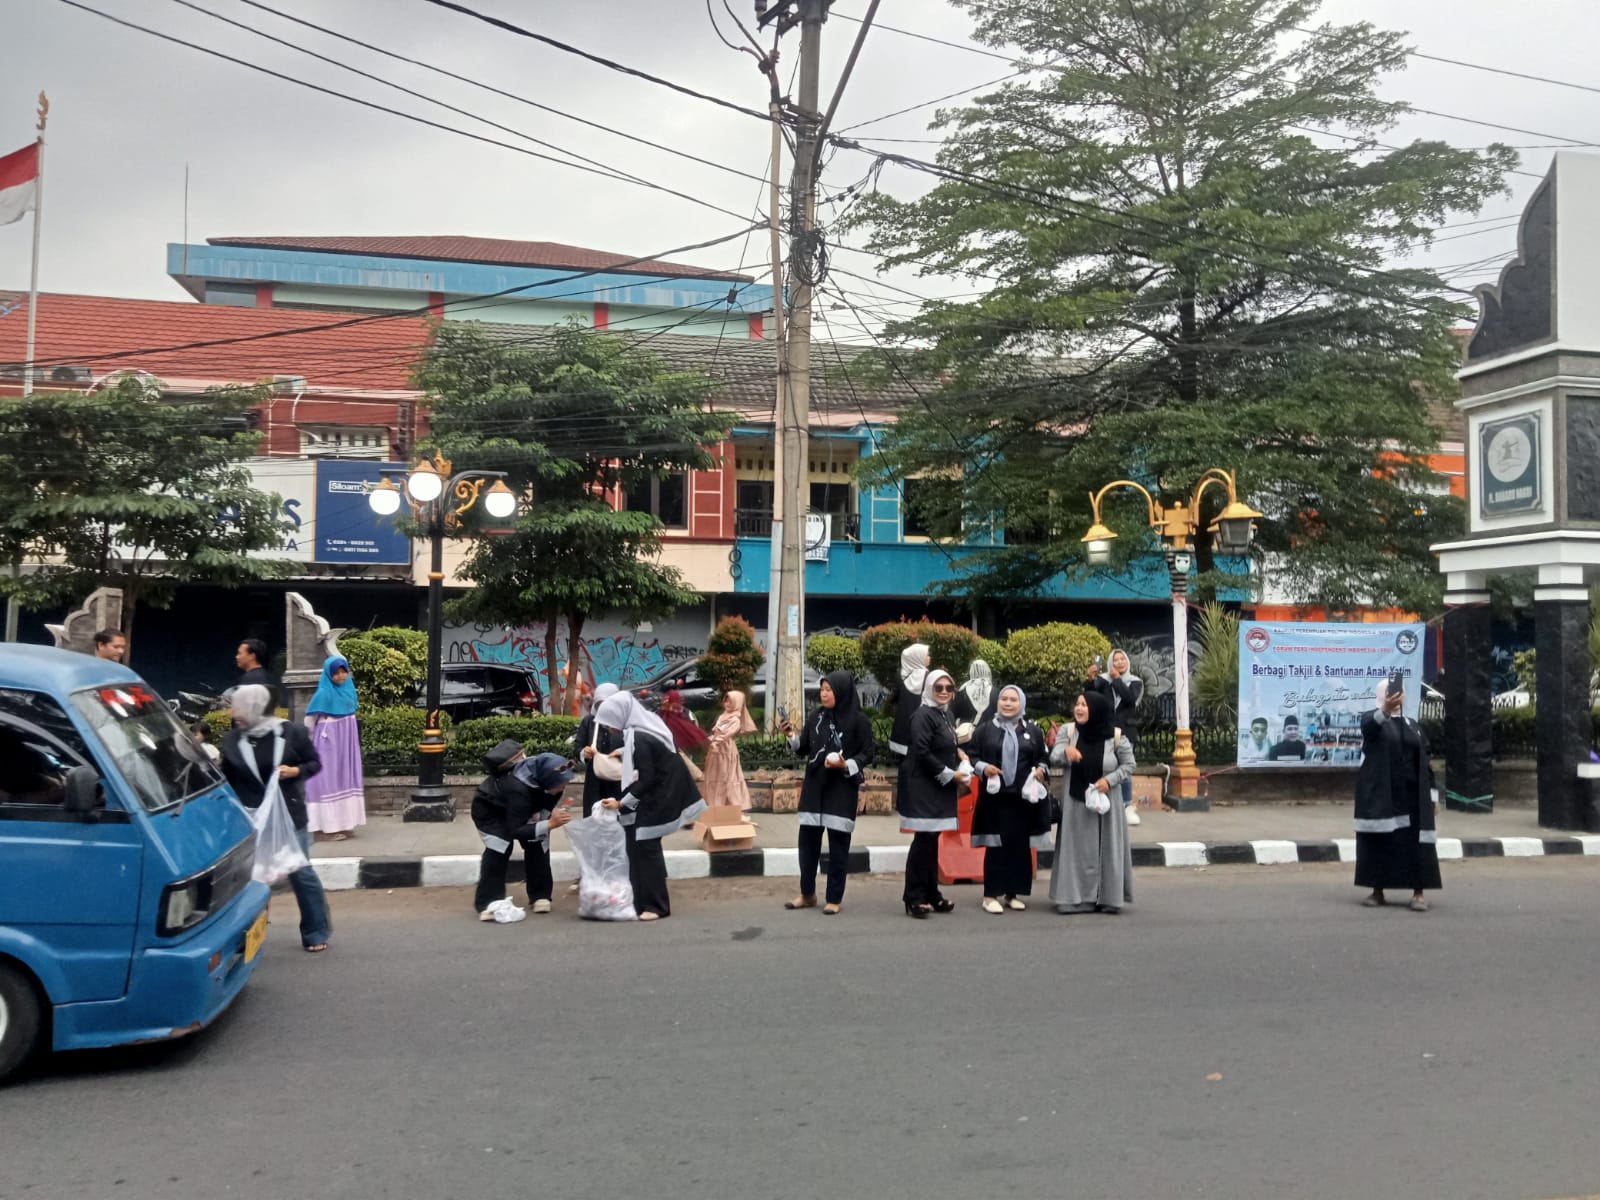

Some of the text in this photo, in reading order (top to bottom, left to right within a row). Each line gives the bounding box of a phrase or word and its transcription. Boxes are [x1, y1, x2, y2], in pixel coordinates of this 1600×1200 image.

[331, 482, 361, 491] Siloam
[1252, 664, 1286, 678] Berbagi
[1288, 664, 1312, 679] Takjil
[1315, 665, 1321, 676] &
[1324, 665, 1364, 677] Santunan
[1366, 665, 1387, 676] Anak
